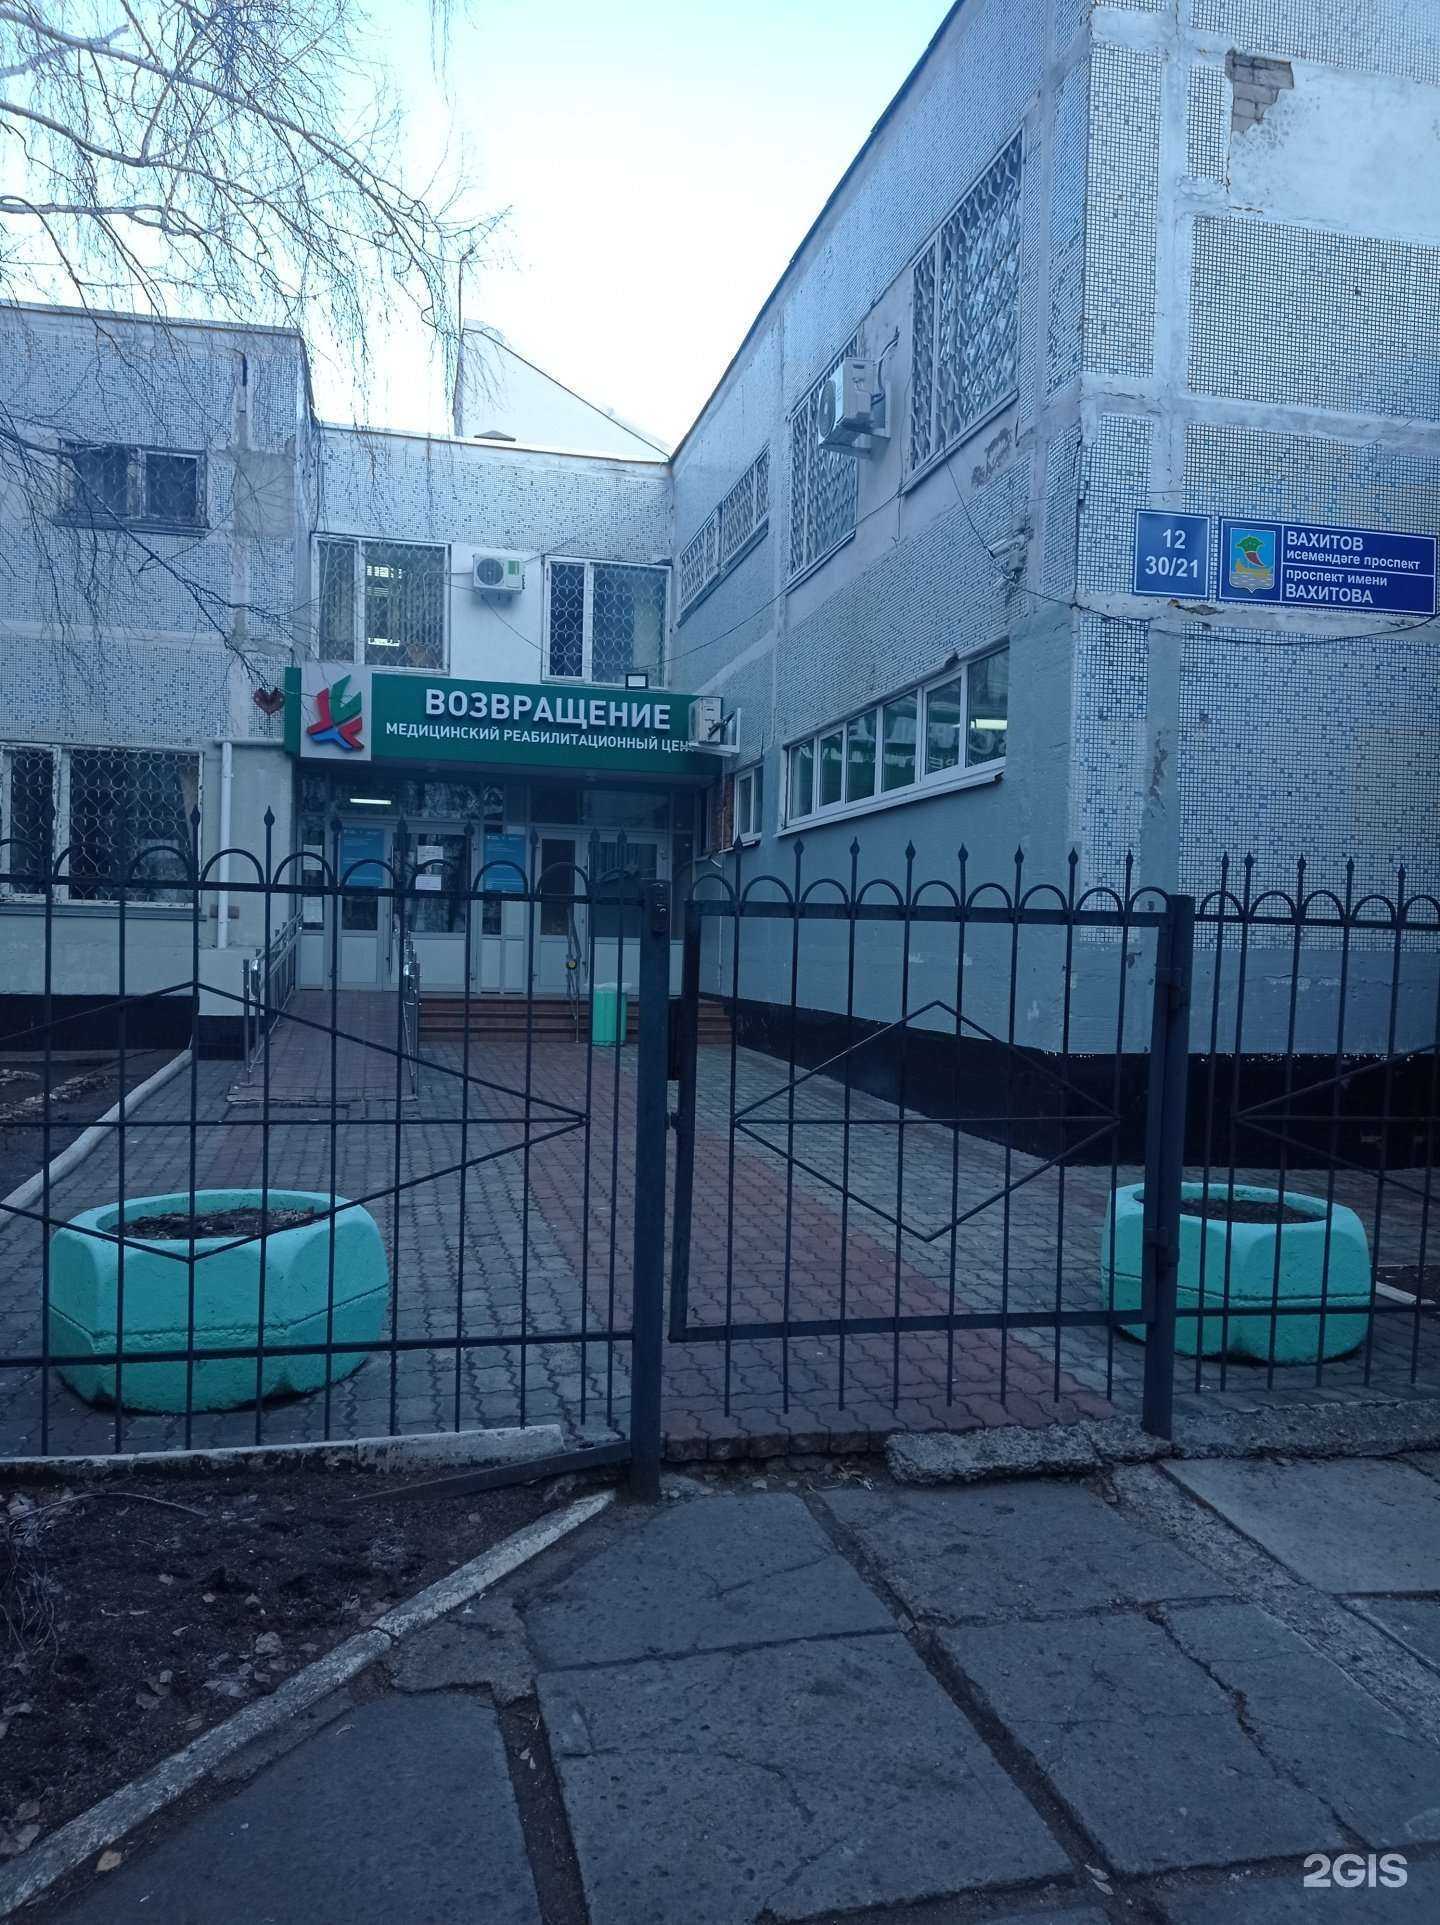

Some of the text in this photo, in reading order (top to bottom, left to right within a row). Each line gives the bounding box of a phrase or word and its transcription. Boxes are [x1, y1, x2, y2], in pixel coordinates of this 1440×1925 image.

[1163, 529, 1186, 549] 12
[1287, 531, 1364, 551] ВАХИТОВ
[1145, 556, 1199, 578] 30/21
[1286, 550, 1420, 570] исемендәге проспект
[1286, 569, 1388, 587] проспект имени
[1286, 584, 1373, 604] ВАХИТОВА
[425, 688, 671, 730] ВОЗВРАЩЕНИЕ
[386, 722, 695, 753] МЕДИЦИНСКИЙ РЕАБИЛИТАЦИОННЫЙ ЦЕН
